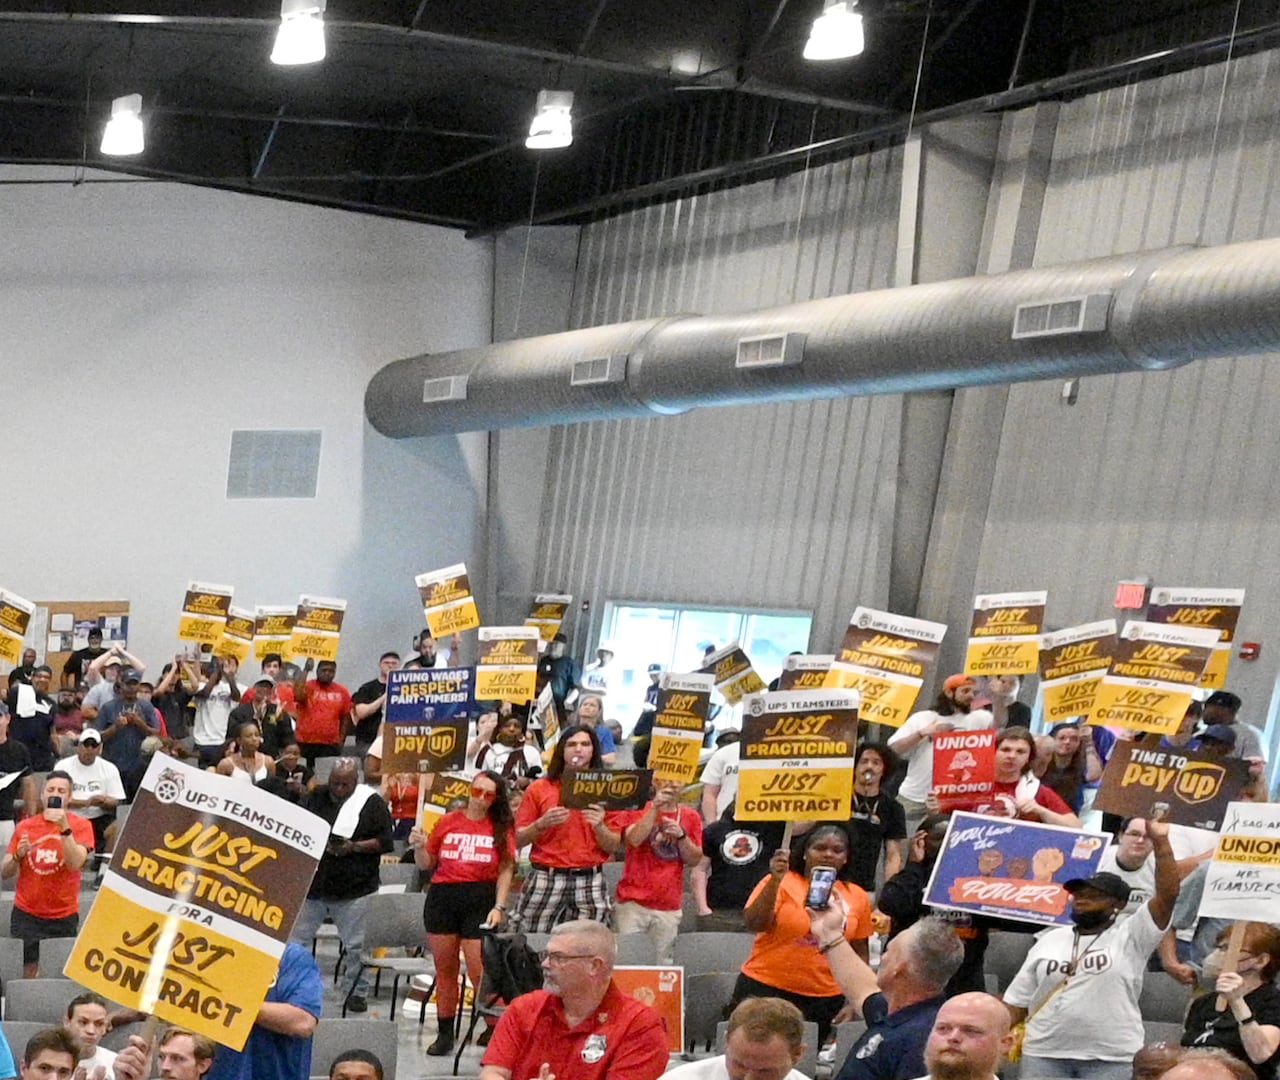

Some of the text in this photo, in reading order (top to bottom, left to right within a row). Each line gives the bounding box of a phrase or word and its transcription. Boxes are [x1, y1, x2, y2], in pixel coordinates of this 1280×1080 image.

[987, 608, 1029, 623] JUST
[1166, 608, 1221, 623] JUST
[434, 617, 474, 633] CONTRACT
[974, 624, 1038, 636] PRACTICING
[491, 641, 526, 653] JUST
[863, 634, 918, 651] JUST
[982, 644, 1023, 656] JUST
[292, 647, 331, 657] CONTRACT
[1056, 641, 1098, 662] JUST
[1133, 644, 1191, 662] JUST
[841, 650, 923, 676] PRACTICING
[970, 660, 1031, 670] CONTRACT
[1045, 656, 1112, 679] PRACTICING
[393, 670, 469, 683] LIVING WAGES
[489, 673, 523, 684] JUST
[1113, 663, 1196, 681] PRACTICING
[401, 680, 463, 696] RESPECT
[1060, 681, 1100, 699] JUST
[391, 693, 468, 704] PART-TIMERS!
[665, 695, 698, 709] JUST
[1116, 690, 1171, 707] JUST
[656, 714, 703, 728] PRACTICING
[765, 715, 833, 735] JUST
[1097, 708, 1175, 727] CONTRACT
[395, 726, 432, 735] TIME TO
[395, 736, 452, 753] pay up
[658, 741, 689, 756] JUST
[746, 741, 847, 756] PRACTICING
[935, 735, 993, 750] UNION
[1130, 749, 1187, 769] TIME TO
[650, 760, 692, 776] CONTRACT
[575, 772, 613, 781] TIME TO
[761, 772, 827, 791] JUST
[1121, 763, 1216, 799] pay up
[574, 781, 632, 795] pay up
[934, 782, 992, 795] STRONG!
[744, 799, 841, 813] CONTRACT
[185, 789, 316, 850] UPS TEAMSTERS:
[164, 822, 278, 874] JUST
[443, 833, 494, 848] STRIKE
[36, 849, 59, 863] PSL
[462, 852, 491, 863] WAGES
[122, 848, 284, 931] PRACTICING
[962, 881, 1060, 904] POWER
[168, 902, 214, 926] FOR A
[122, 922, 235, 971] JUST
[1084, 956, 1108, 973] up
[84, 948, 242, 1028] CONRACT
